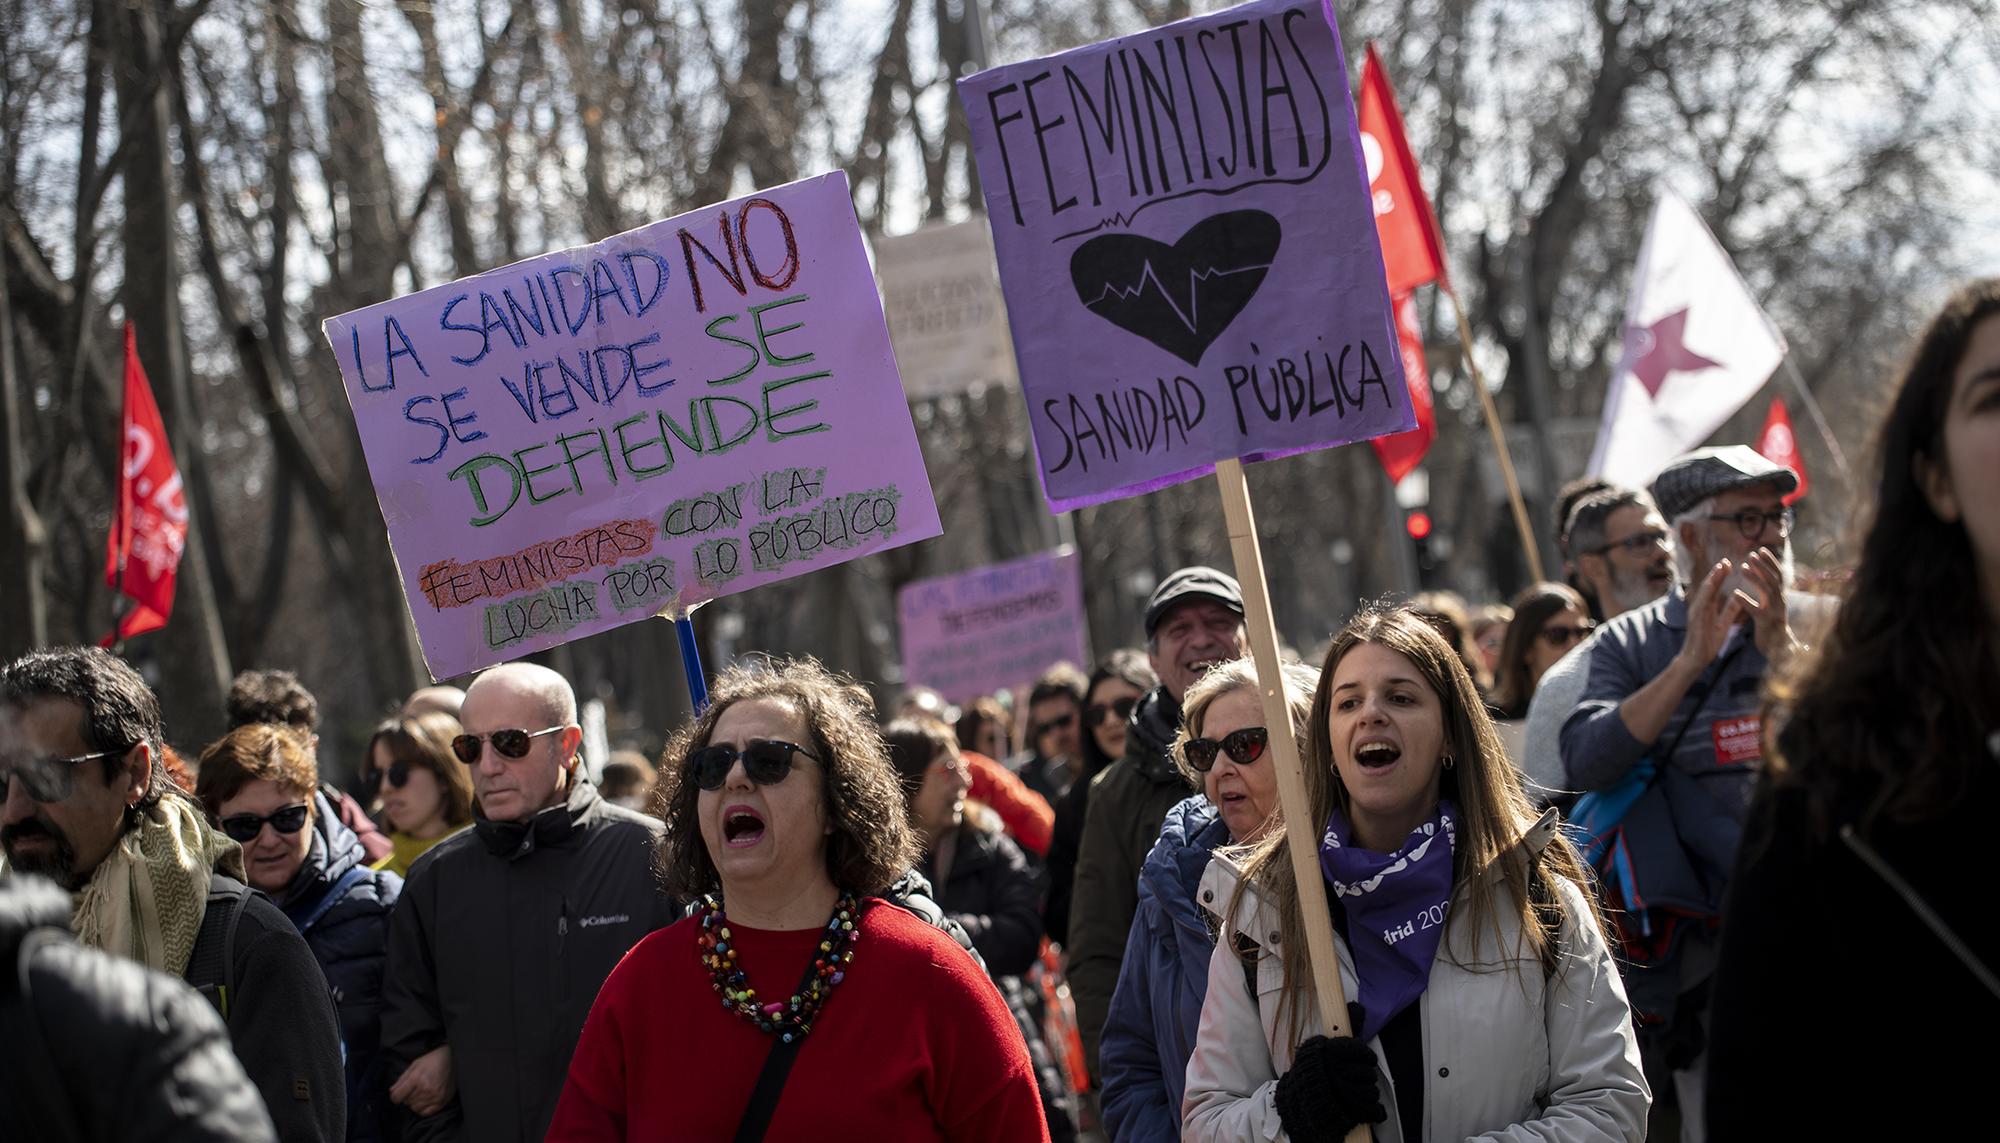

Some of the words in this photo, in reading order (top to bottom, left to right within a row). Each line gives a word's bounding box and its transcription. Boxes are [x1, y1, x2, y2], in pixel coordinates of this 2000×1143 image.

[987, 8, 1332, 227] FEMINISTAS
[352, 314, 429, 393] LA
[440, 250, 670, 367] SANIDAD
[677, 198, 800, 313] NO
[402, 387, 488, 464] SE
[500, 333, 677, 424] VENDE
[704, 294, 817, 387] SE
[447, 370, 838, 527] DEFIENDE
[1043, 375, 1205, 474] SANIDAD
[420, 521, 650, 613] FEMINISTAS
[665, 487, 744, 536] CON
[764, 470, 821, 511] LA
[487, 586, 594, 646] LUCHA
[601, 563, 673, 604] POR
[695, 541, 738, 580] LO
[748, 497, 897, 565] PÚBLICO
[588, 914, 630, 926] Columbia
